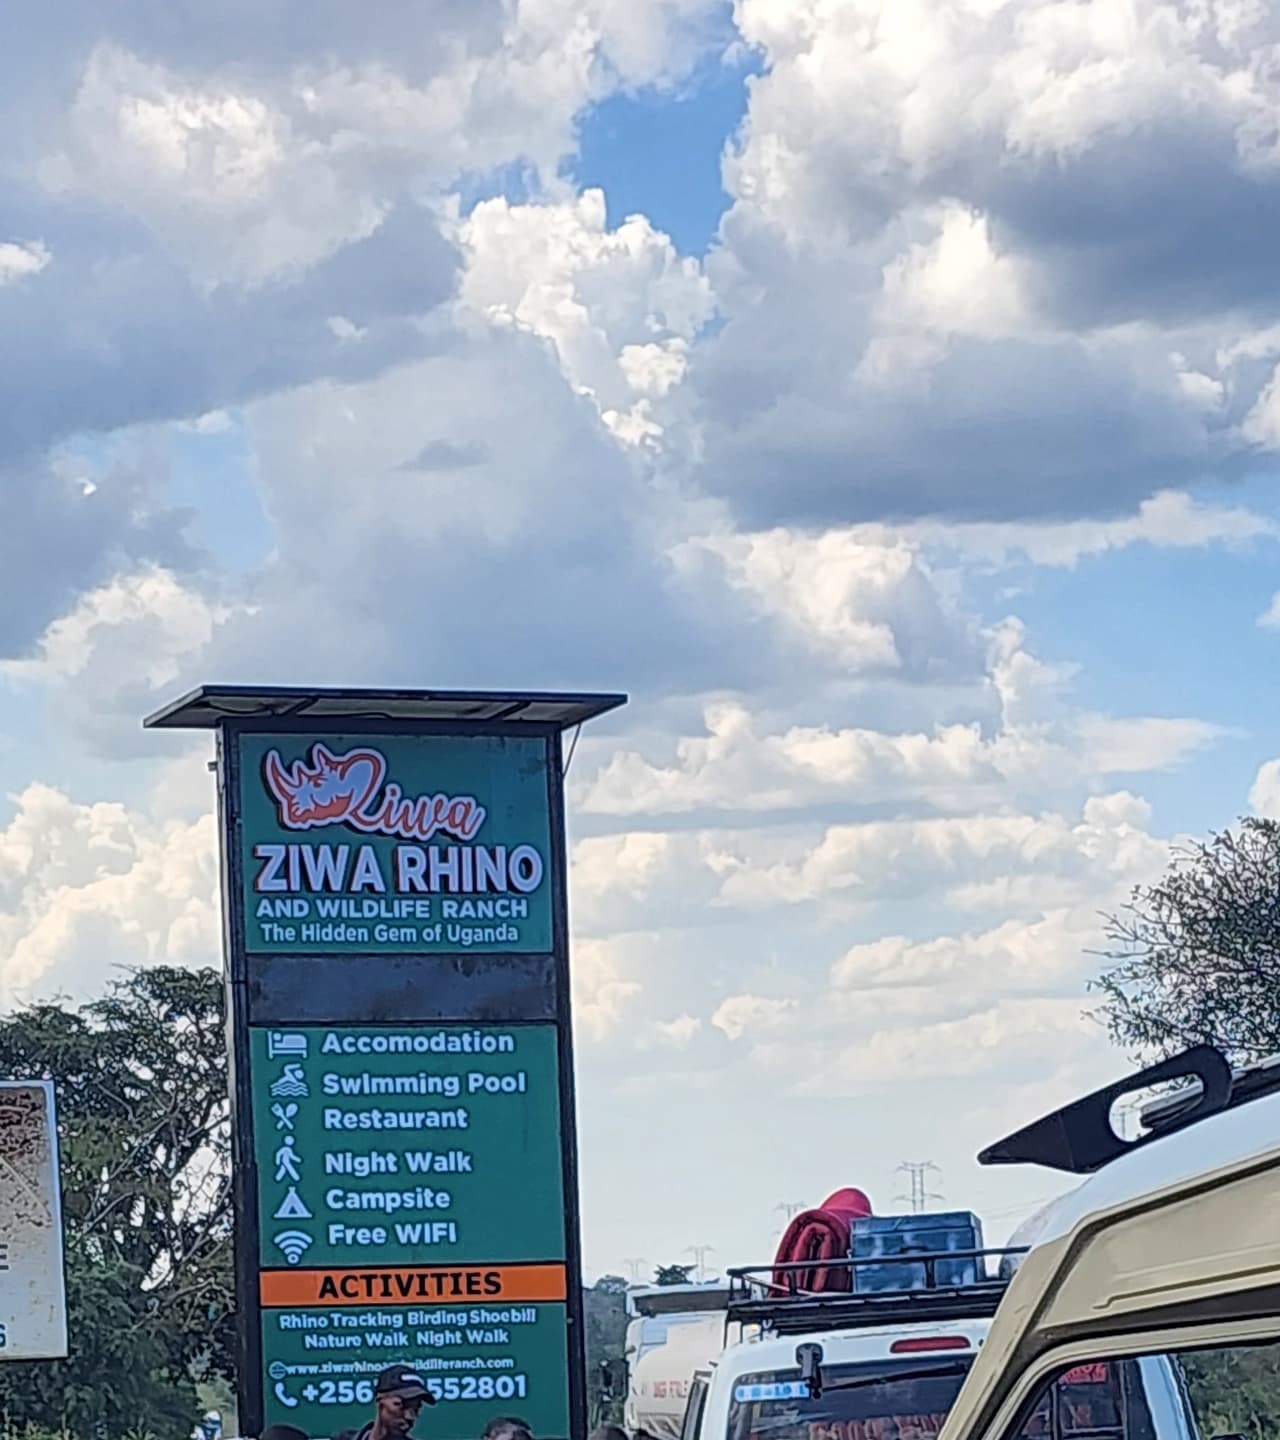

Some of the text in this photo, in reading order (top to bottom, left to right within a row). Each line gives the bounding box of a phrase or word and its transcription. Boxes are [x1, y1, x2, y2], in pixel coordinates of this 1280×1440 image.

[255, 844, 543, 893] ZIWA RHINO
[256, 900, 527, 918] AND WILDLIFE RANCH
[261, 923, 518, 946] The Hidden Gem of Uganda
[321, 1030, 515, 1053] Accomodation
[322, 1072, 525, 1096] Swimming Pool
[324, 1108, 468, 1129] Restaurant
[325, 1151, 472, 1176] Night Walk
[326, 1188, 451, 1213] Campsite
[328, 1224, 387, 1245] Free
[319, 1272, 502, 1299] ACTIVITIES
[279, 1308, 536, 1330] Rhino Tracking Birding Shoebill
[304, 1328, 509, 1349] Nature Walk Night Walk
[302, 1375, 526, 1404] +256552801
